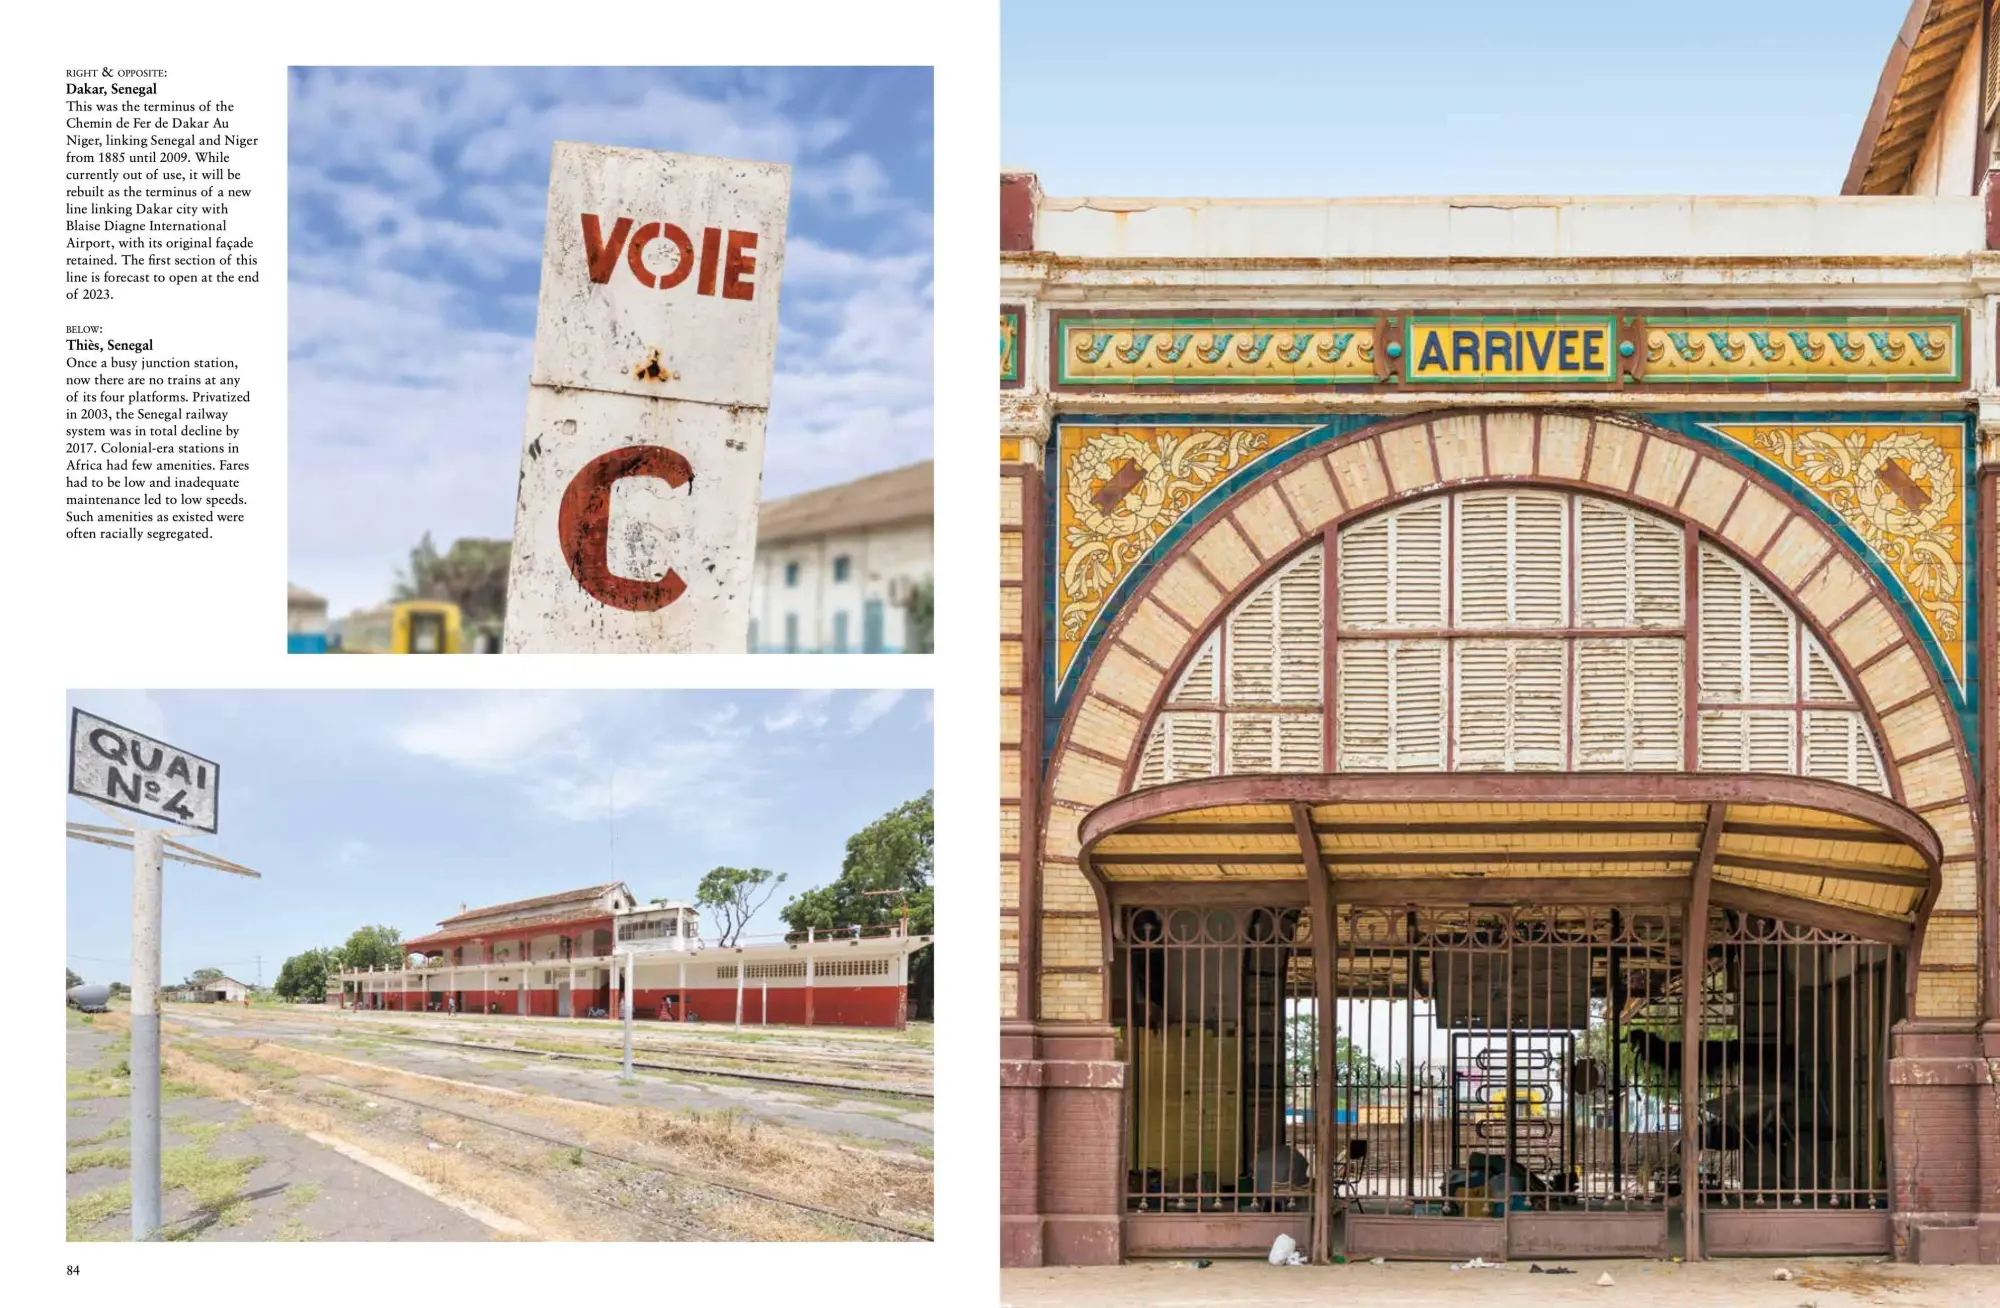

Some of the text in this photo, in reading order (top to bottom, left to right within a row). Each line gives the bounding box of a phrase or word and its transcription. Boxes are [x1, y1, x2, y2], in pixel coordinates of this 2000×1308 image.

[66, 66, 168, 78] RIGHT & OPPOSITE:
[65, 82, 157, 98] Dakar, Senegal
[65, 99, 235, 112] This was the terminus of the
[66, 116, 229, 129] Chemin de Fer de Dakar Au
[66, 133, 259, 149] Niger, linking Senegal and Niger
[66, 151, 230, 163] from 1885 until 2009. While
[65, 168, 241, 183] currently out of use, it will be
[66, 185, 252, 198] rebuilt as the terminus of a new
[66, 202, 229, 217] line linking Dakar city with
[66, 219, 227, 234] Blaise Diagne International
[66, 236, 254, 252] Airport, with its original façade
[66, 253, 258, 266] retained. The first section of this
[581, 213, 759, 301] VOIE
[66, 270, 259, 286] line is forecast to open at the end
[65, 287, 114, 300] of 2023.
[65, 325, 103, 334] BELOW:
[65, 338, 154, 354] Thiès, Senegal
[1417, 330, 1605, 371] ARRIVEE
[66, 356, 239, 371] Once a busy junction station,
[66, 373, 241, 388] now there are no trains at any
[65, 390, 251, 406] of its four platforms. Privatized
[66, 407, 229, 423] in 2003, the Senegal railway
[66, 424, 240, 439] system was in total decline by
[65, 441, 239, 454] 2017. Colonial-era stations in
[65, 458, 250, 471] Africa had few amenities. Fares
[66, 475, 240, 491] had to be low and inadequate
[66, 493, 247, 508] maintenance led to low speeds.
[65, 510, 245, 522] Such amenities as existed were
[65, 526, 213, 542] often racially segregated.
[558, 445, 695, 612] C
[89, 728, 207, 790] QUAI
[66, 1264, 80, 1276] 84
